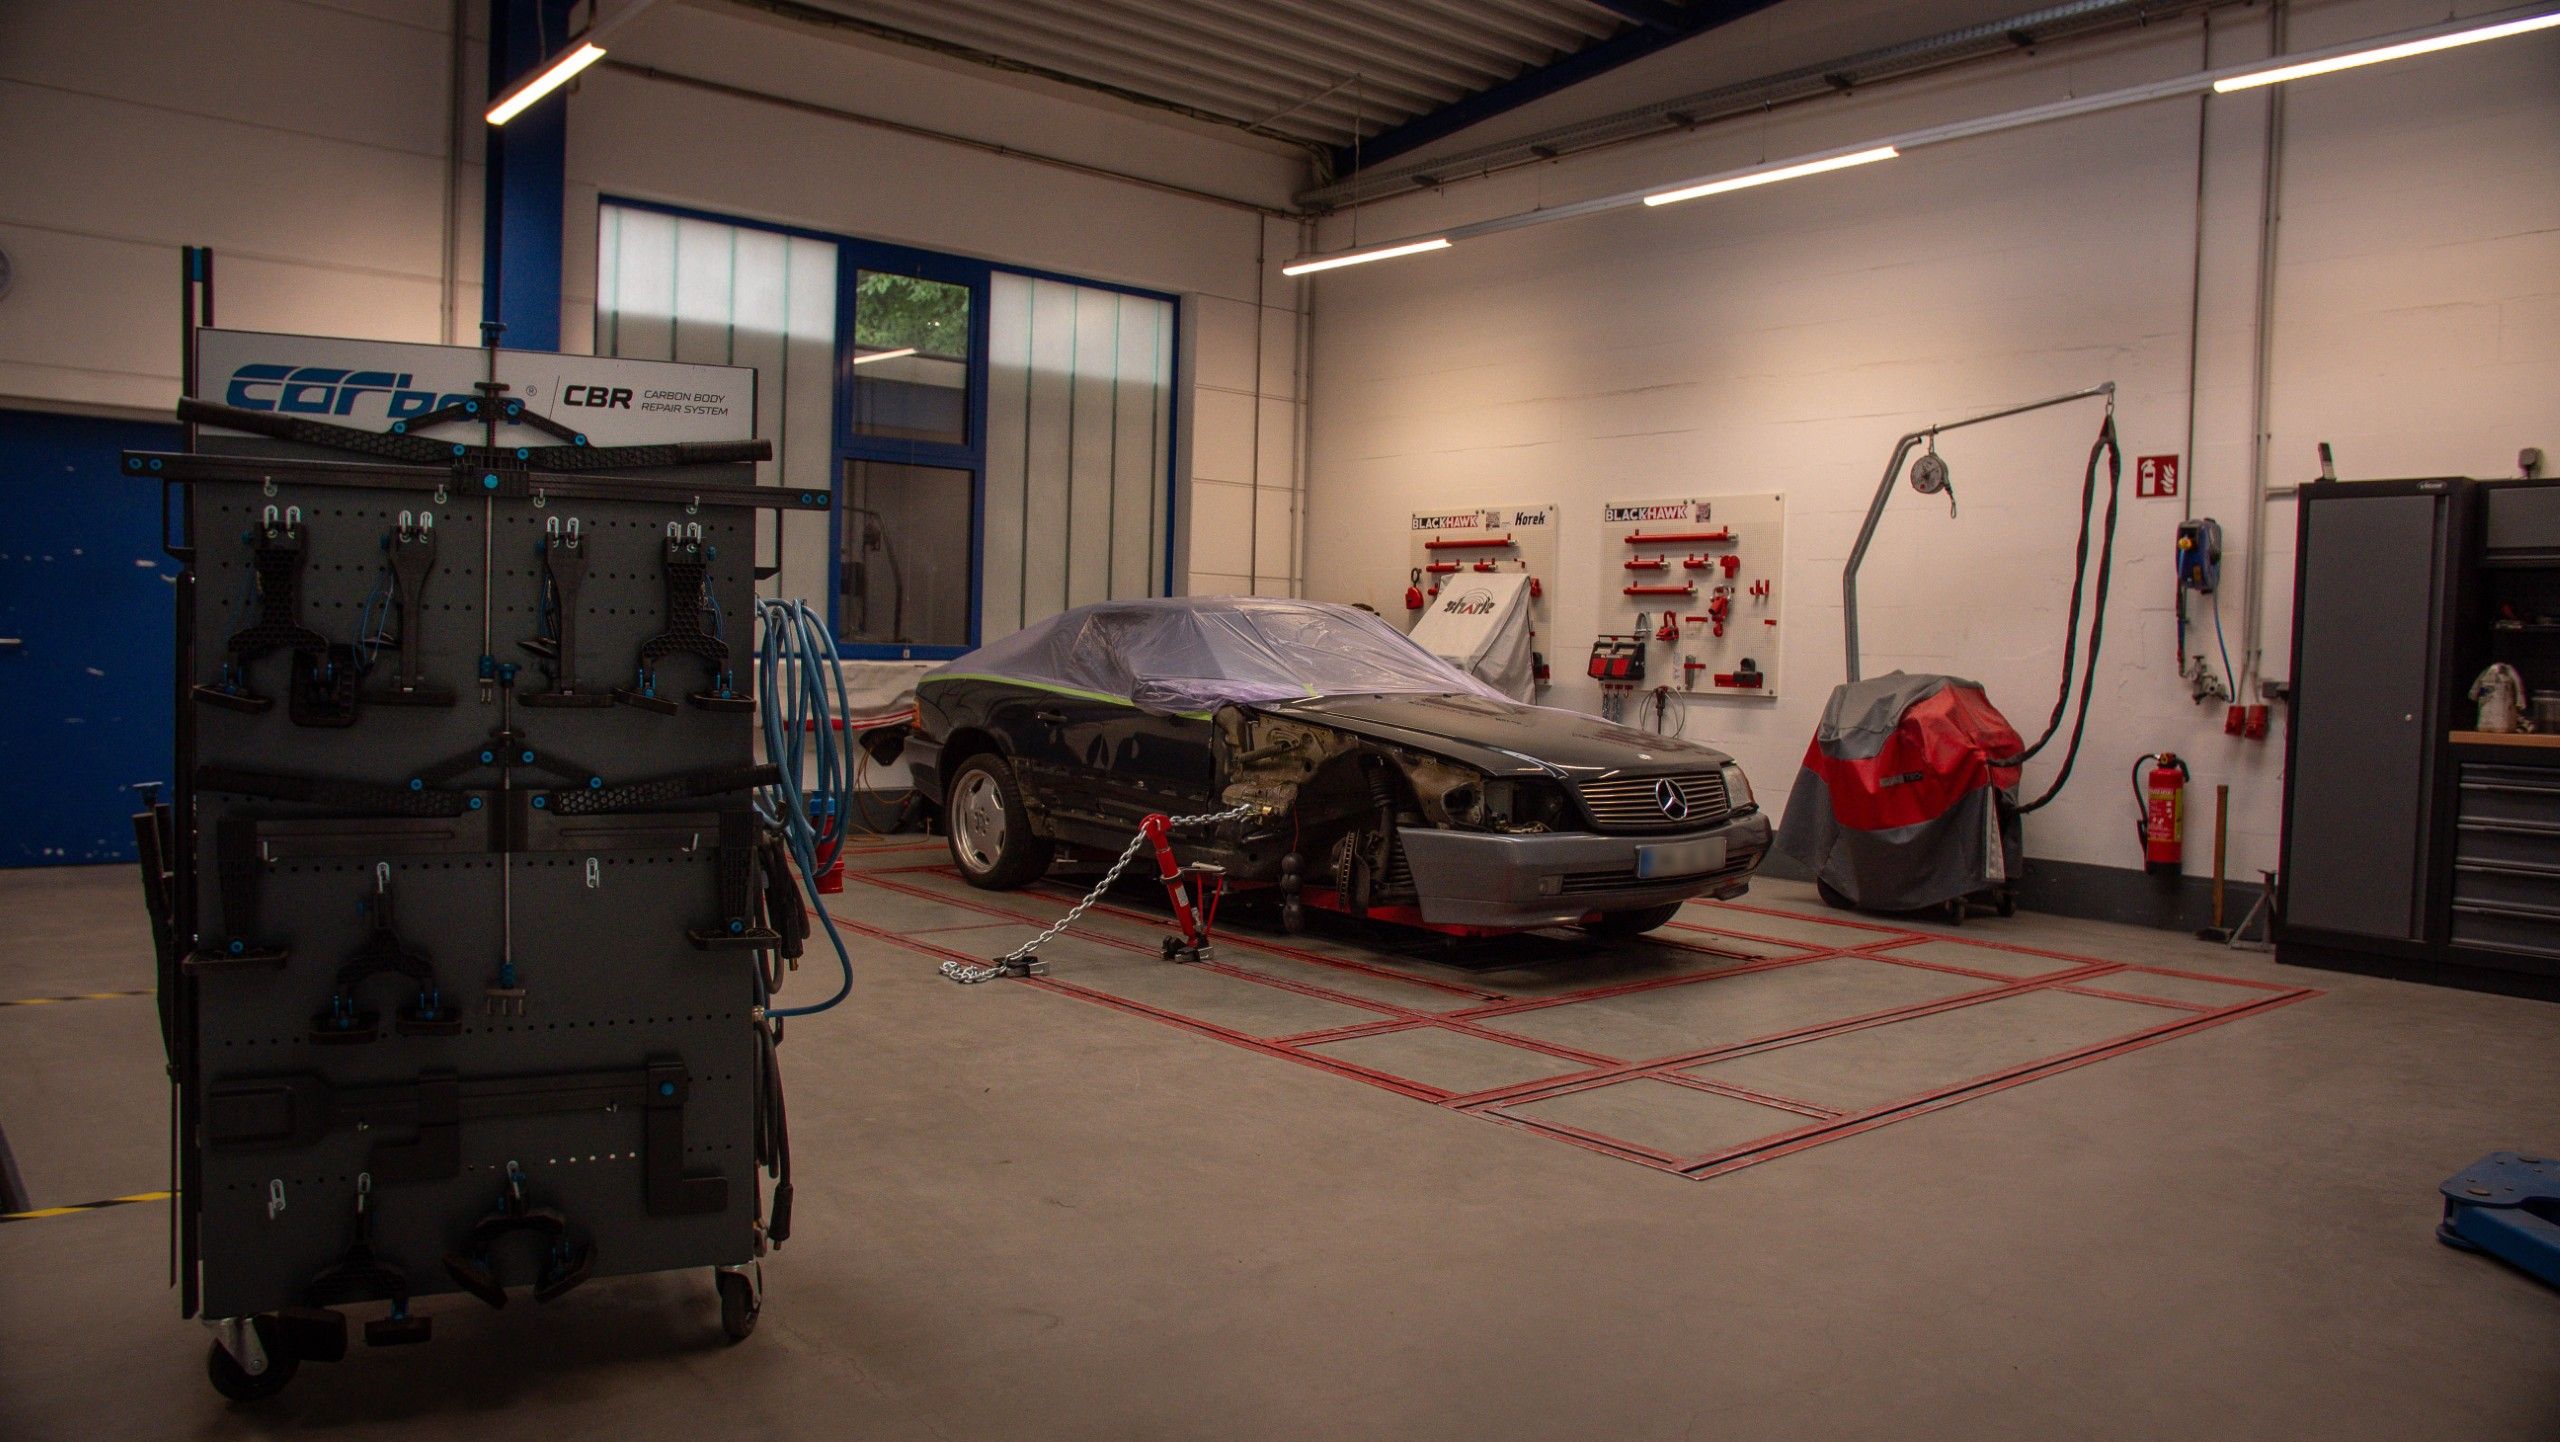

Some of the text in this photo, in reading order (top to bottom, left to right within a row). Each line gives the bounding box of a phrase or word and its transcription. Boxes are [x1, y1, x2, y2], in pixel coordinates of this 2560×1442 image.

[563, 385, 633, 409] CBR
[644, 390, 726, 404] CARBON BODY
[641, 402, 729, 417] REPAIR SYSTEM
[1515, 511, 1546, 526] Korek
[1605, 505, 1688, 522] BLACKHAWK
[1412, 515, 1479, 530] BLACKHAWK
